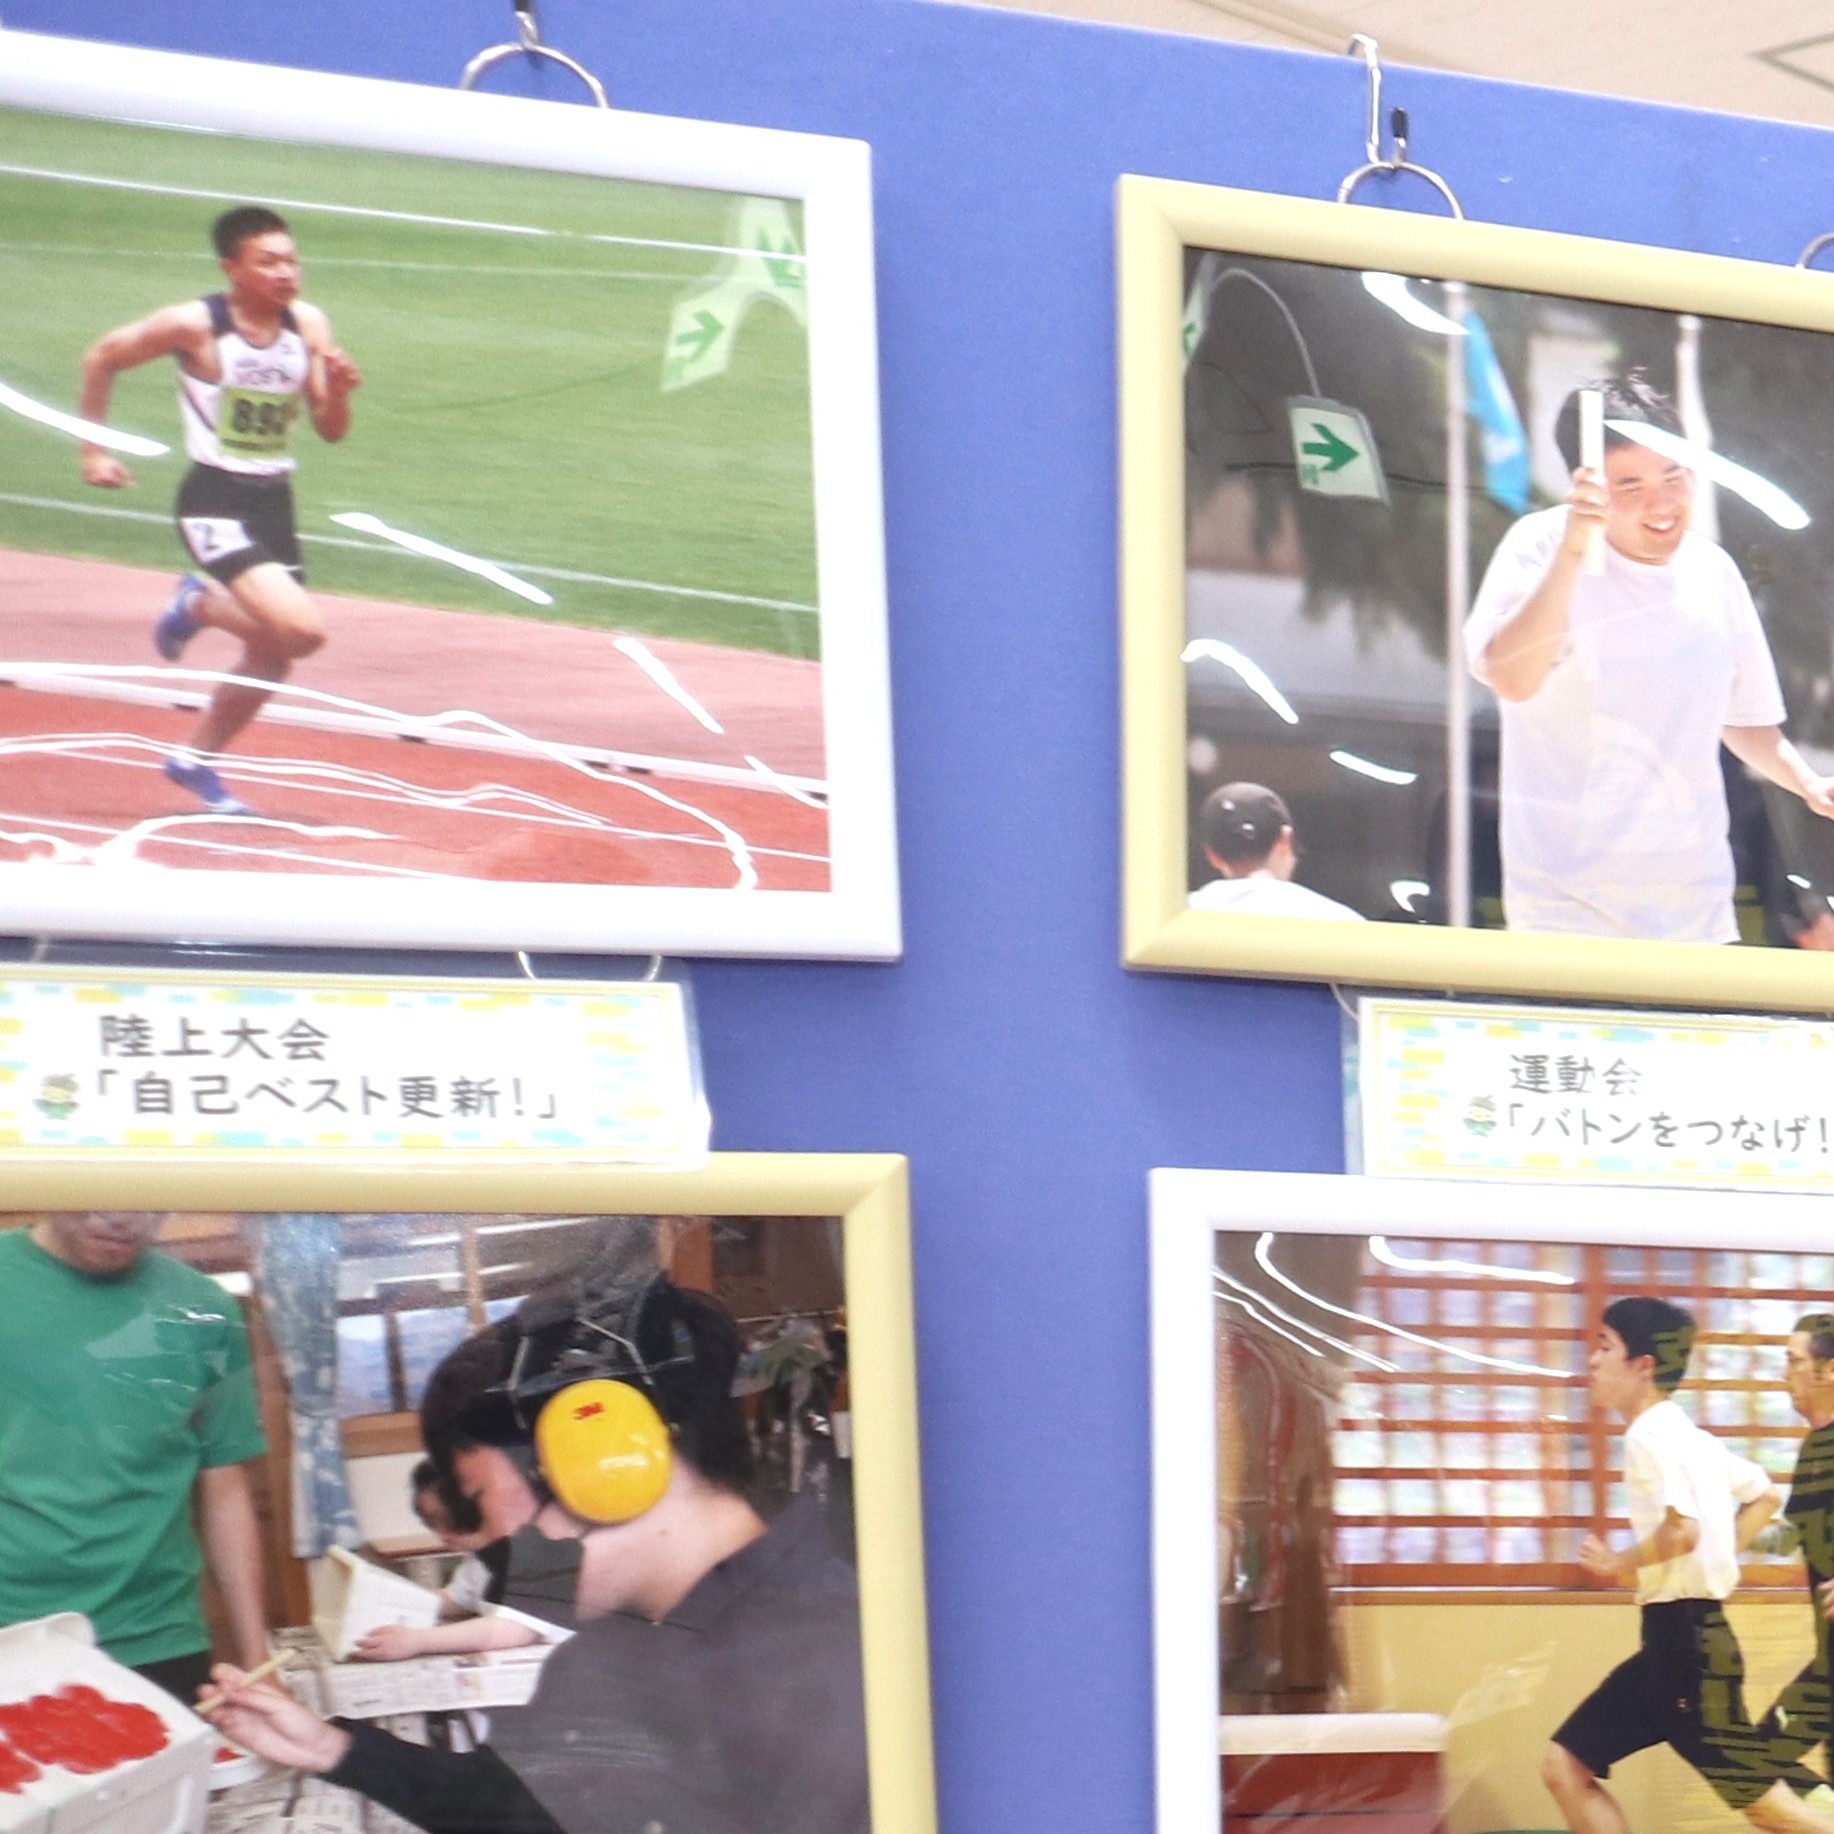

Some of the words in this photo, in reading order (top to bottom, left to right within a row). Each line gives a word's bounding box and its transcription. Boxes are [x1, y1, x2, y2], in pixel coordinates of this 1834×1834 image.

[101, 1014, 330, 1062] 陸上大会
[98, 1070, 557, 1120] 「自己ベスト更新！」
[1509, 1054, 1643, 1097] 運動会
